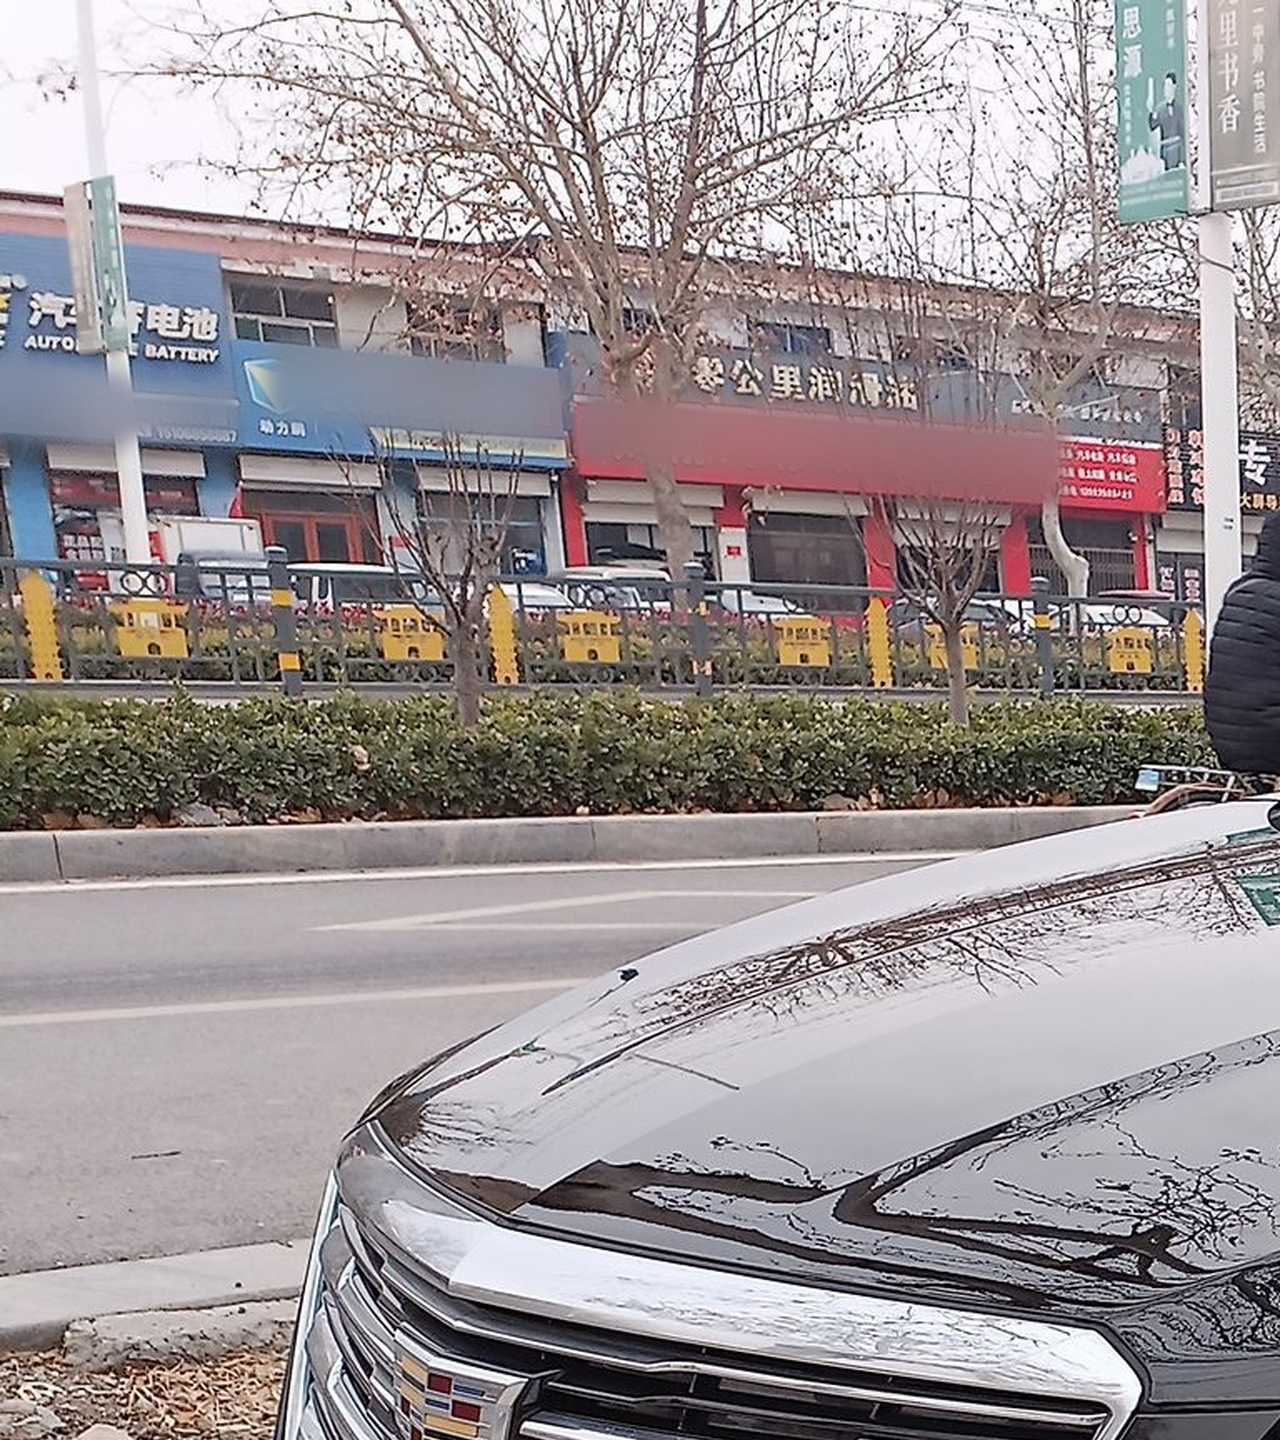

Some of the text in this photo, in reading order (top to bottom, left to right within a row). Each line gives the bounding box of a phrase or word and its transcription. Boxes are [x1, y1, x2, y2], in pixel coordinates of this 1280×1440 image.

[1218, 0, 1241, 134] 里书香
[28, 292, 219, 342] 汽电池
[145, 344, 220, 362] BATTERY
